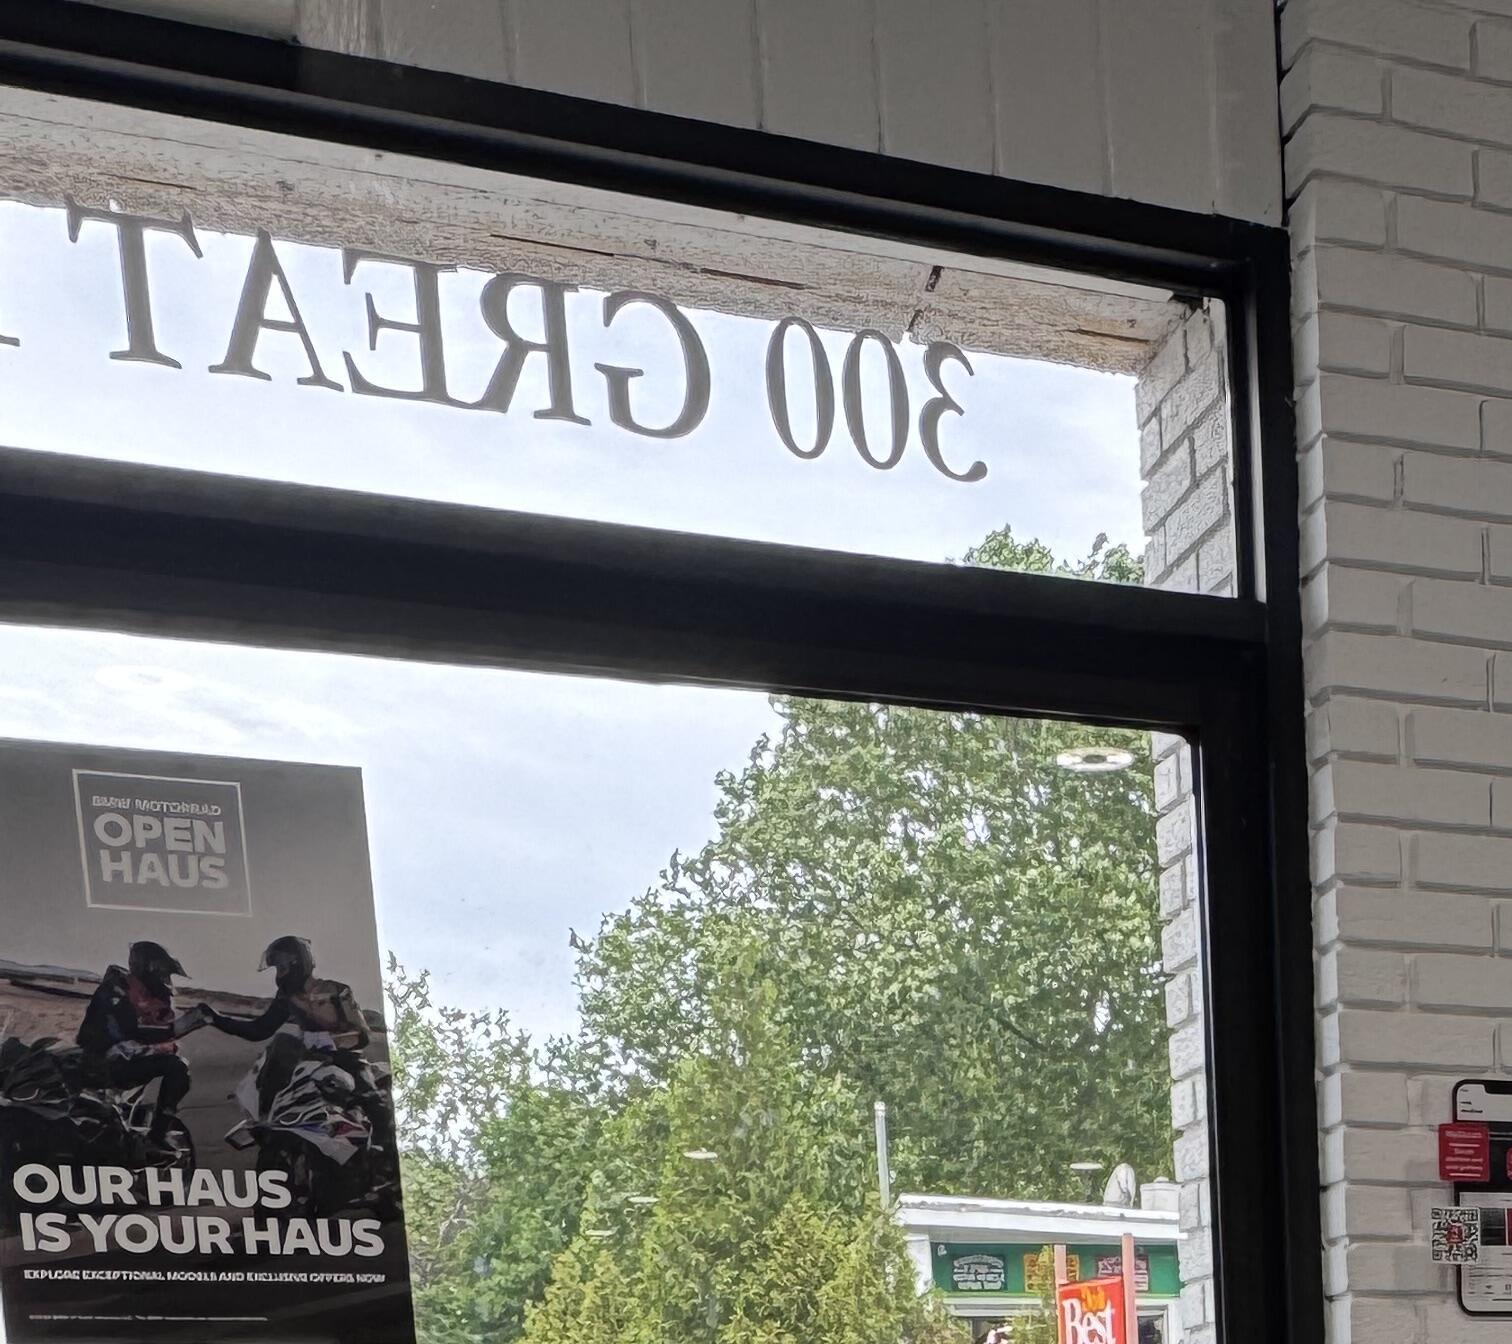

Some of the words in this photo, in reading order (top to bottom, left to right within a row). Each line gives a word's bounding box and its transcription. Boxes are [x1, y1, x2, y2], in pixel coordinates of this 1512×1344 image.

[93, 812, 226, 854] OPEN
[100, 849, 229, 889] HAUS
[13, 1163, 137, 1205] OUR
[146, 1167, 292, 1210] HAUS
[20, 1212, 72, 1252] IS
[78, 1213, 234, 1255] YOUR
[242, 1217, 385, 1258] HAUS
